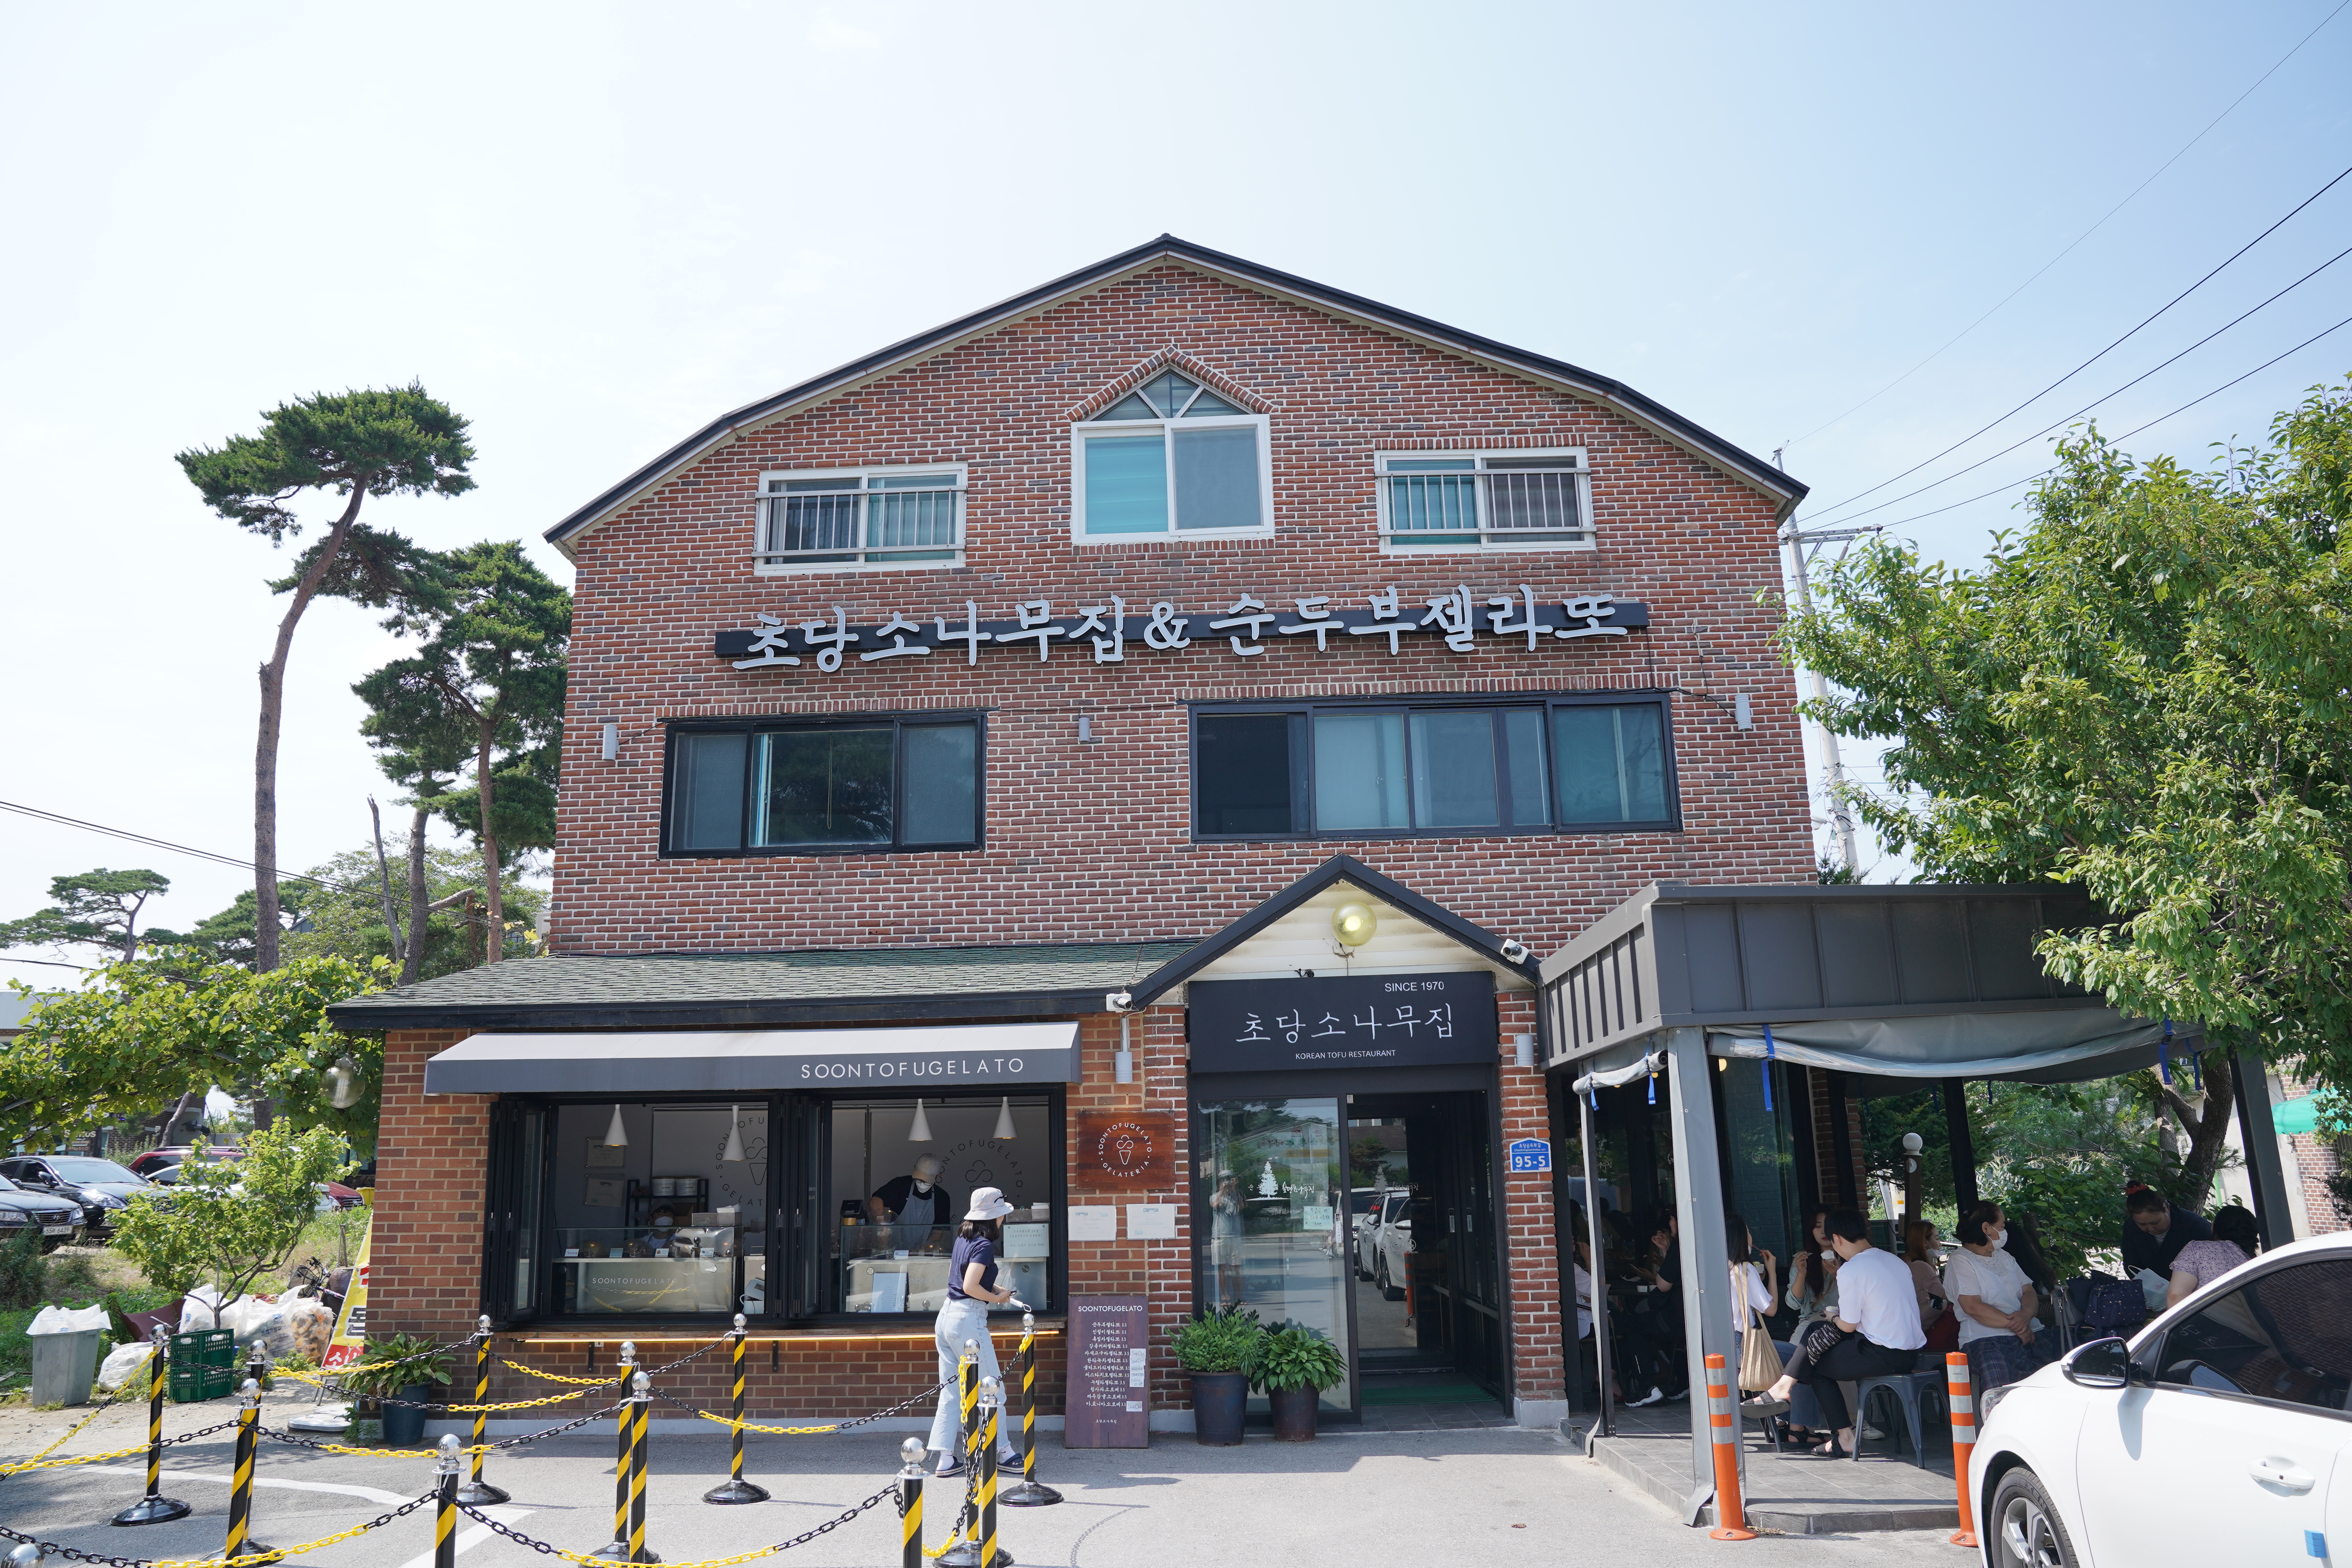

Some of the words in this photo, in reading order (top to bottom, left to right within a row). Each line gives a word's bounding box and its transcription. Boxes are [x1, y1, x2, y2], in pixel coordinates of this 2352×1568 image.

[732, 596, 1126, 672] 초당소나무집
[1143, 601, 1191, 650] &
[1209, 583, 1628, 656] 순두부젤라또
[1384, 982, 1417, 992] SINCE
[1421, 981, 1445, 991] 1970
[1235, 1002, 1453, 1044] 초당소나무집
[1348, 1049, 1396, 1058] RESTAURANT
[801, 1058, 1024, 1079] SOONTOFUGELATO
[1098, 1122, 1152, 1155] SOONTOFUGELATO
[1102, 1160, 1149, 1178] GELATERIA
[1515, 1155, 1546, 1168] 95-5
